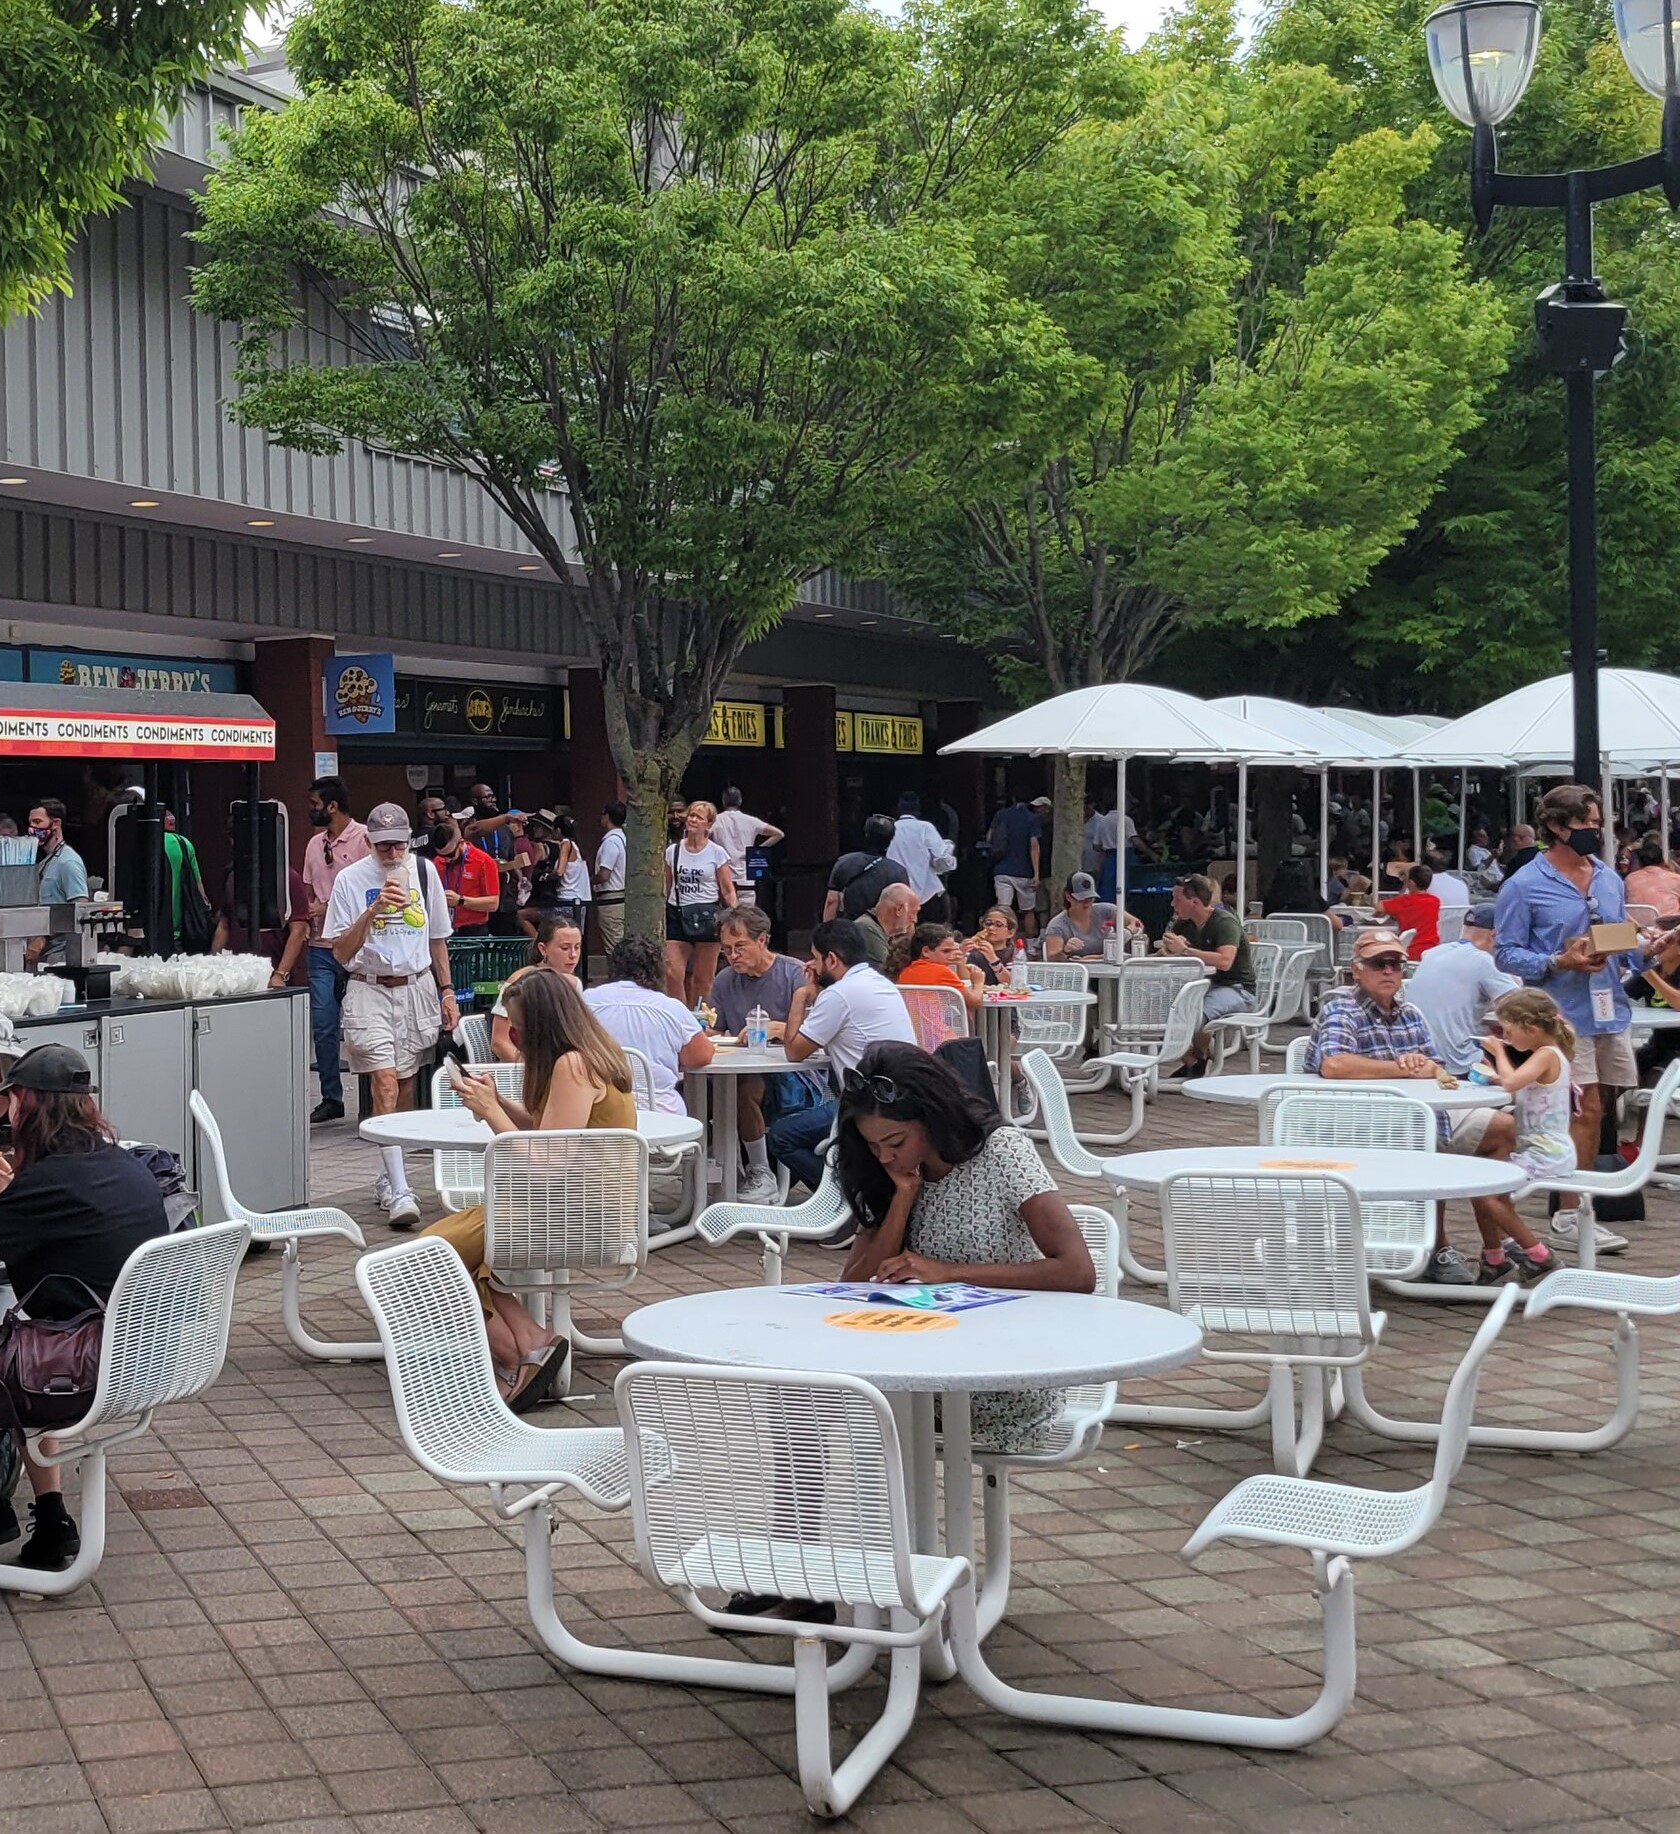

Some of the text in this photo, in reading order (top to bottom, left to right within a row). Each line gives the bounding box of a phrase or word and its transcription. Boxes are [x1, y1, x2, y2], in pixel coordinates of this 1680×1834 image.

[77, 664, 211, 693] BEN JERRY'S
[57, 723, 129, 739] CONDIMENTS
[136, 726, 204, 742] CONDIMENTS
[211, 729, 273, 744] CONDIMENTS
[732, 710, 757, 739] FRIES
[861, 720, 889, 747] FRANKS
[898, 723, 918, 748] FRIES
